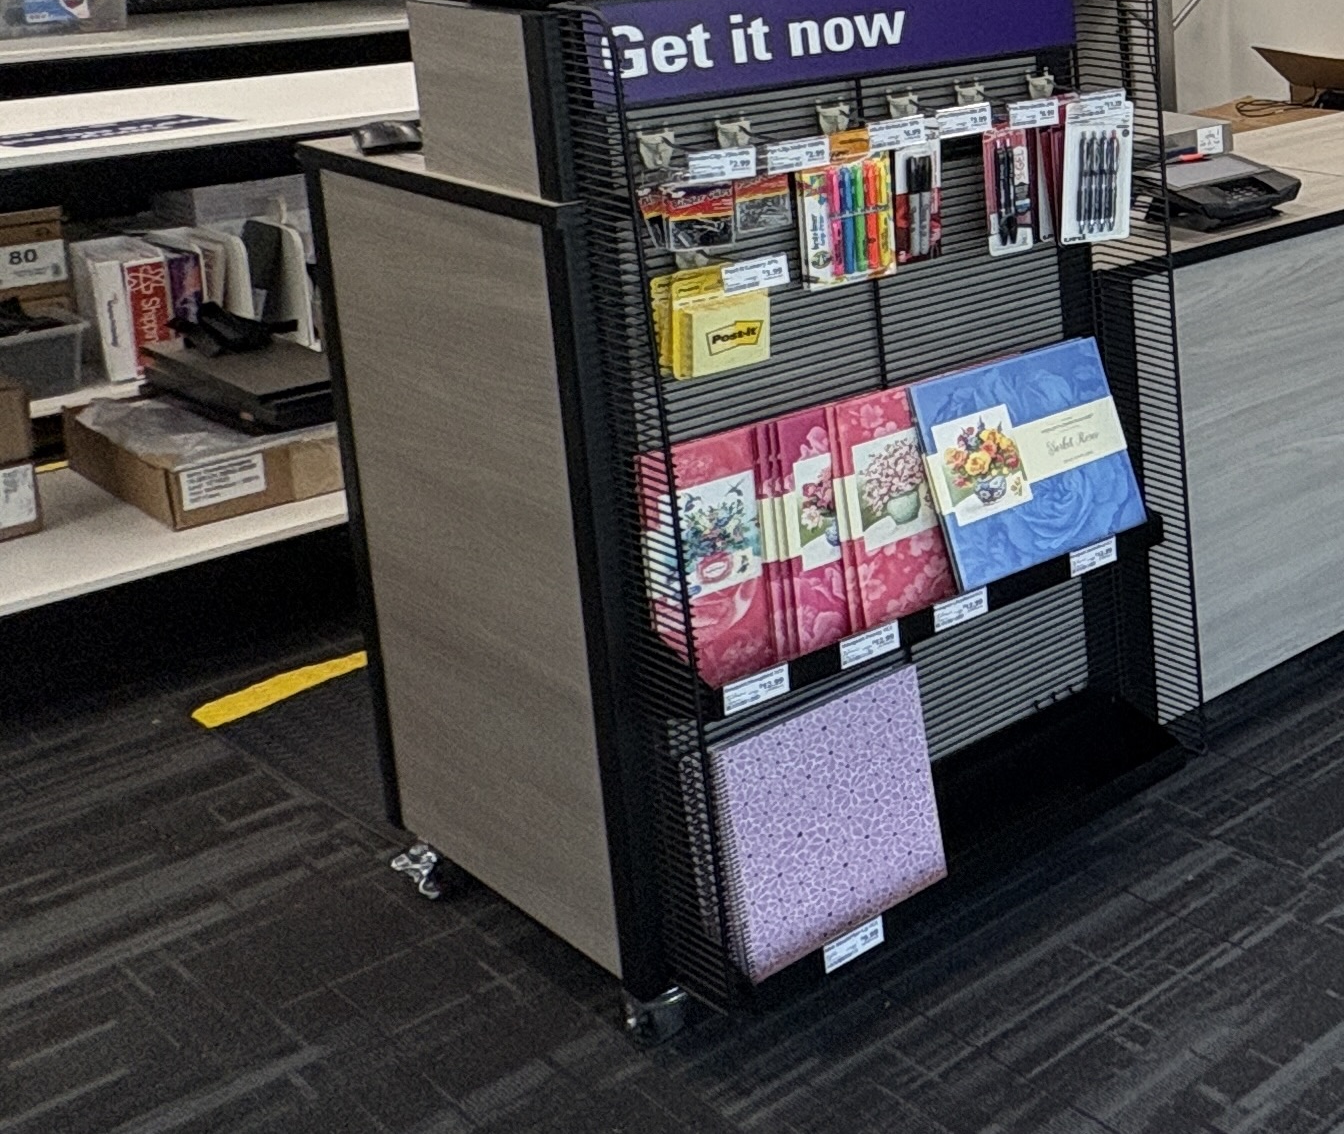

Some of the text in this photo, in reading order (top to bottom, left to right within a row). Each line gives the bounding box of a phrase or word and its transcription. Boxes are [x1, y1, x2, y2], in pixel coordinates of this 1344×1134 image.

[601, 10, 905, 79] Get it now
[9, 248, 38, 265] 80
[712, 327, 757, 344] Post-it
